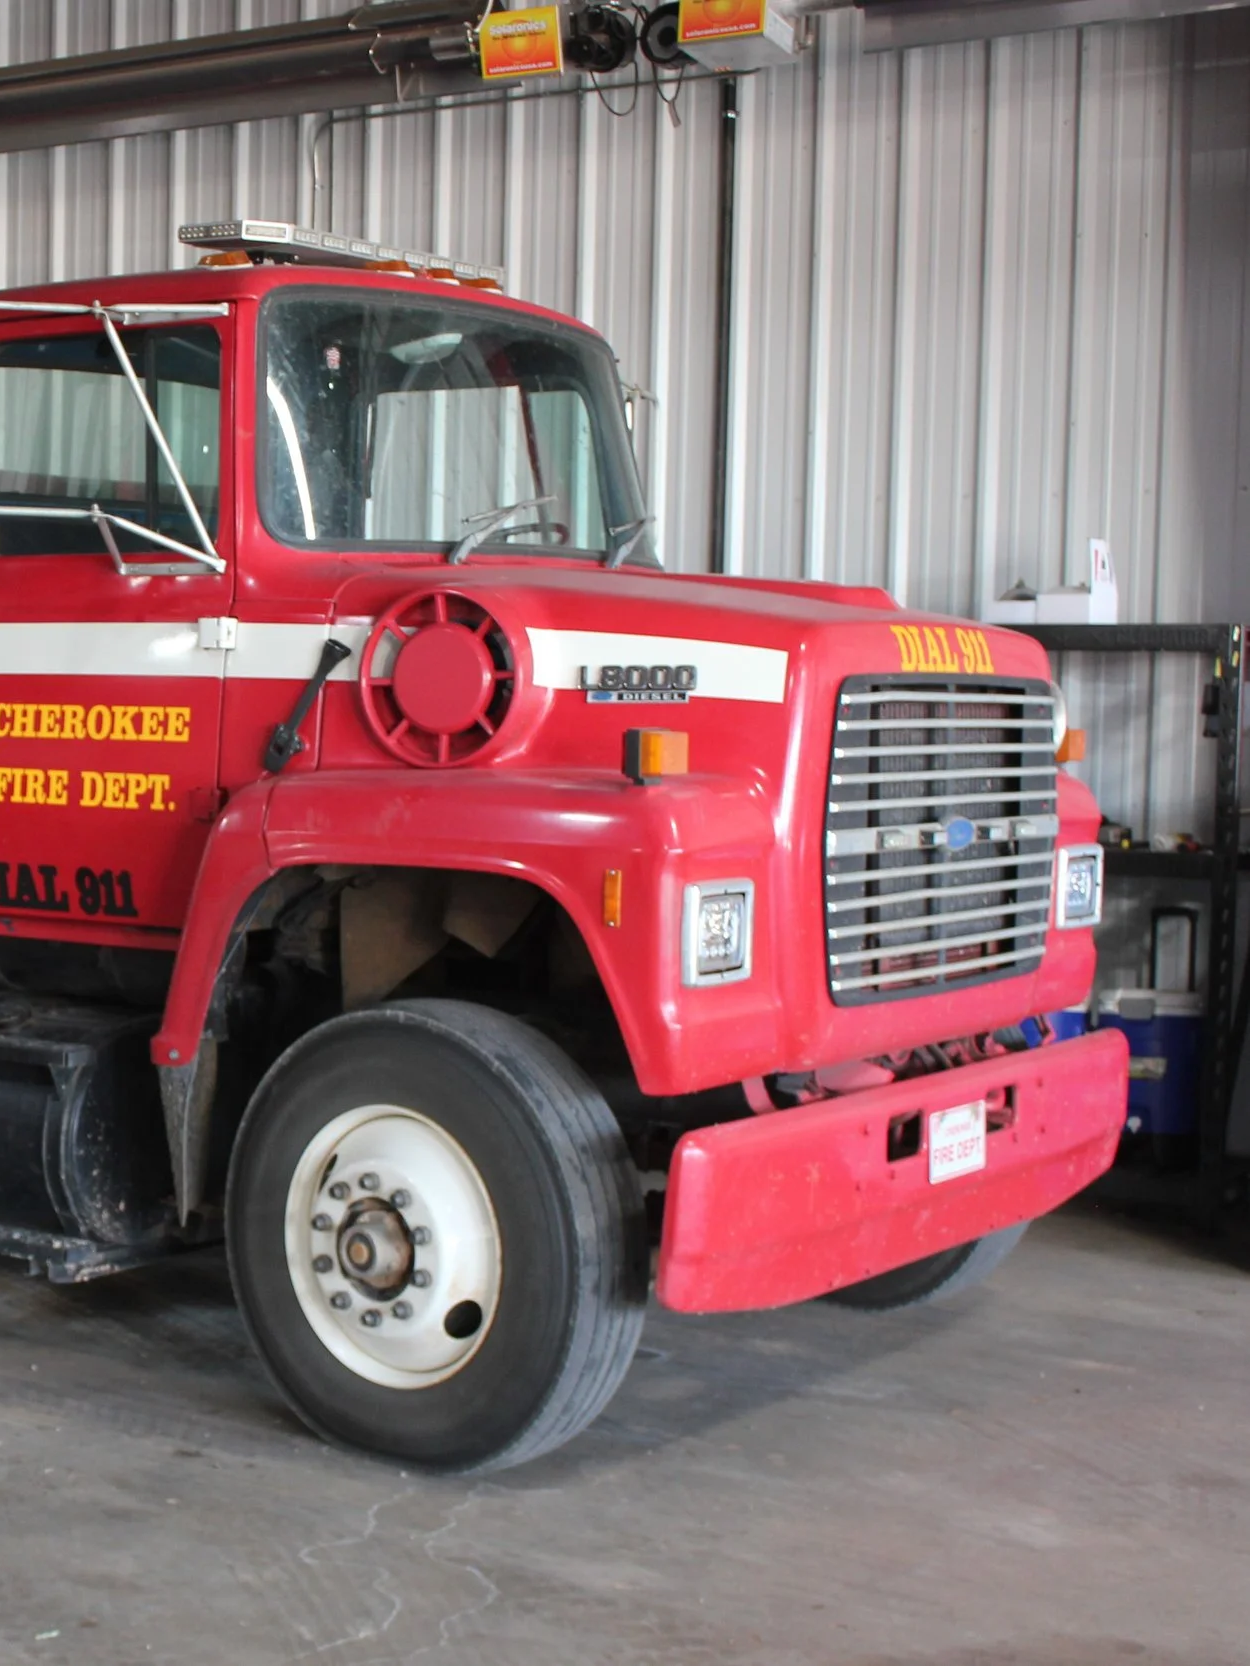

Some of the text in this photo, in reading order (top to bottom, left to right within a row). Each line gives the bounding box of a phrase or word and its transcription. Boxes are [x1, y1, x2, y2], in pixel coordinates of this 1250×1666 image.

[890, 624, 995, 675] DIAL 911
[577, 665, 697, 690] L8000
[621, 692, 685, 701] DIESEL
[79, 770, 176, 811] DEPT.
[75, 866, 139, 917] 911
[933, 1135, 981, 1165] FIRE DEPT
